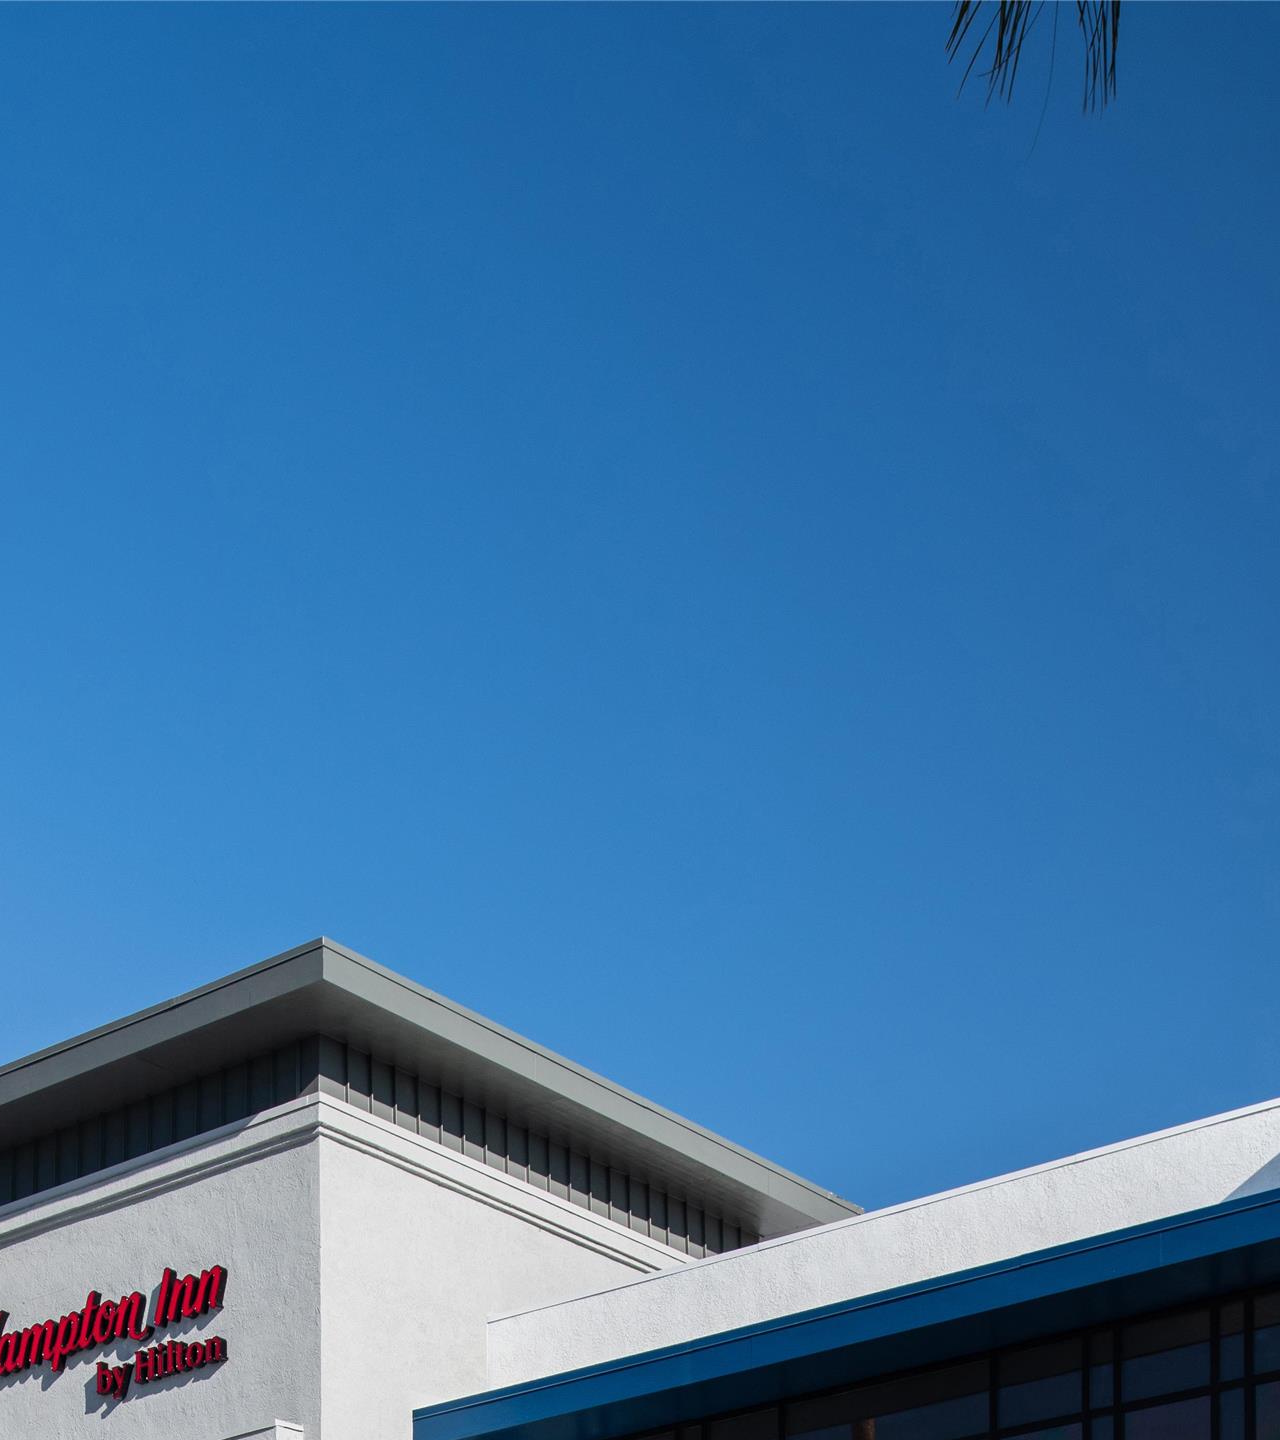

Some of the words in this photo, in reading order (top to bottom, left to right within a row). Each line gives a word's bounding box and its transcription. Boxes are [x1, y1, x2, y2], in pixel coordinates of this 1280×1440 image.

[153, 1264, 228, 1328] Inn
[96, 1361, 134, 1401] by
[135, 1336, 228, 1384] Hilton
